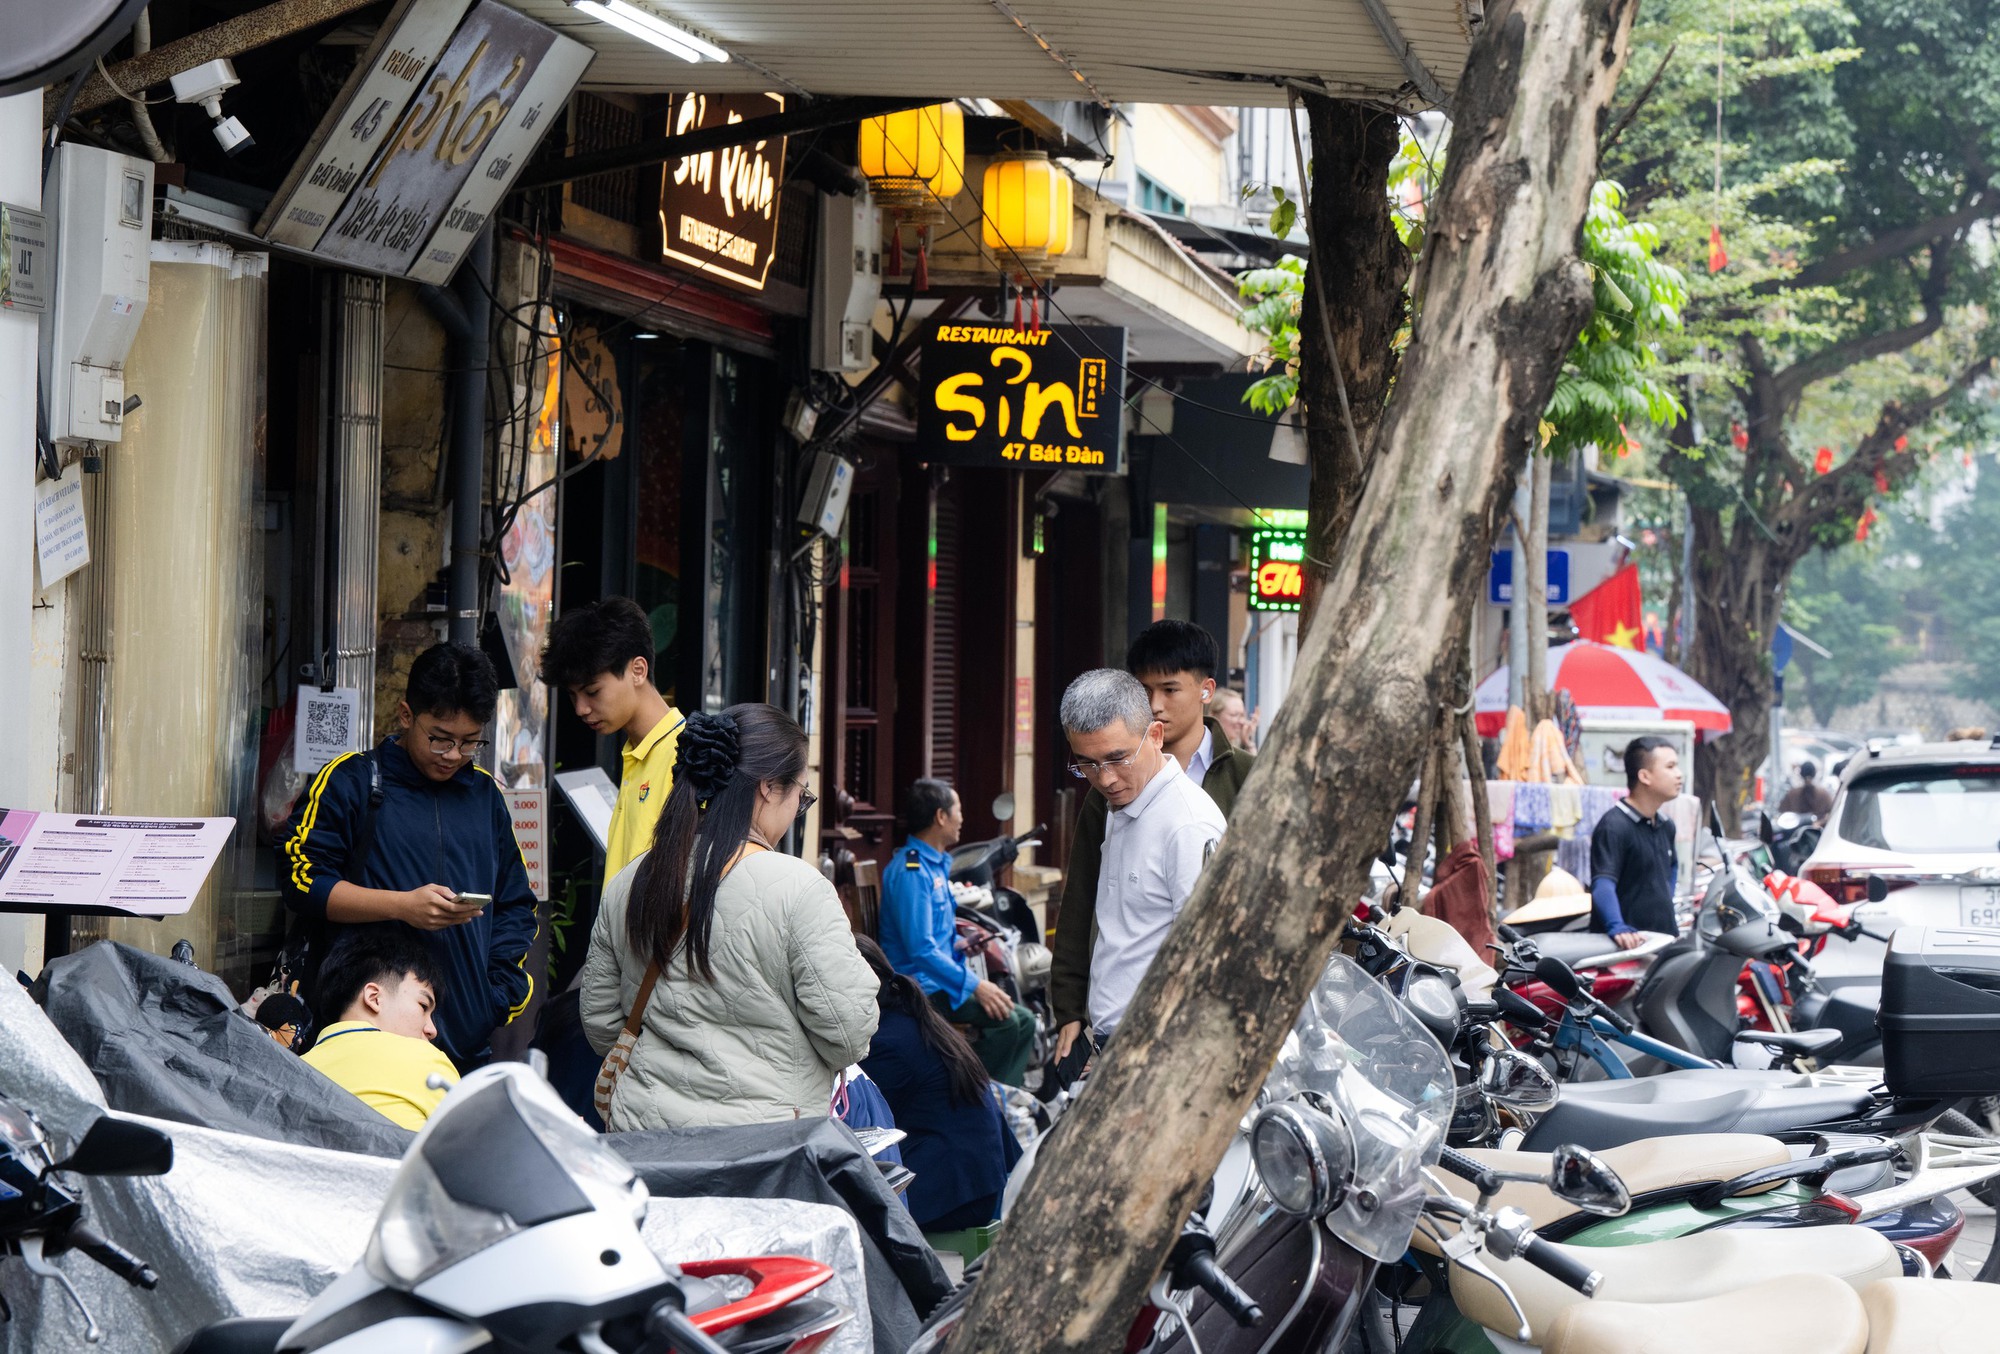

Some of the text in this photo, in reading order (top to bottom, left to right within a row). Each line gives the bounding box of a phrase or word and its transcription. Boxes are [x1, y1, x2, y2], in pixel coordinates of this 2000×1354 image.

[350, 97, 393, 143] 45
[366, 40, 526, 189] phở
[937, 325, 1052, 346] RESTAURANT
[1001, 443, 1104, 464] 47 Bát Đàn
[520, 840, 539, 850] .000
[1985, 887, 2000, 905] 3
